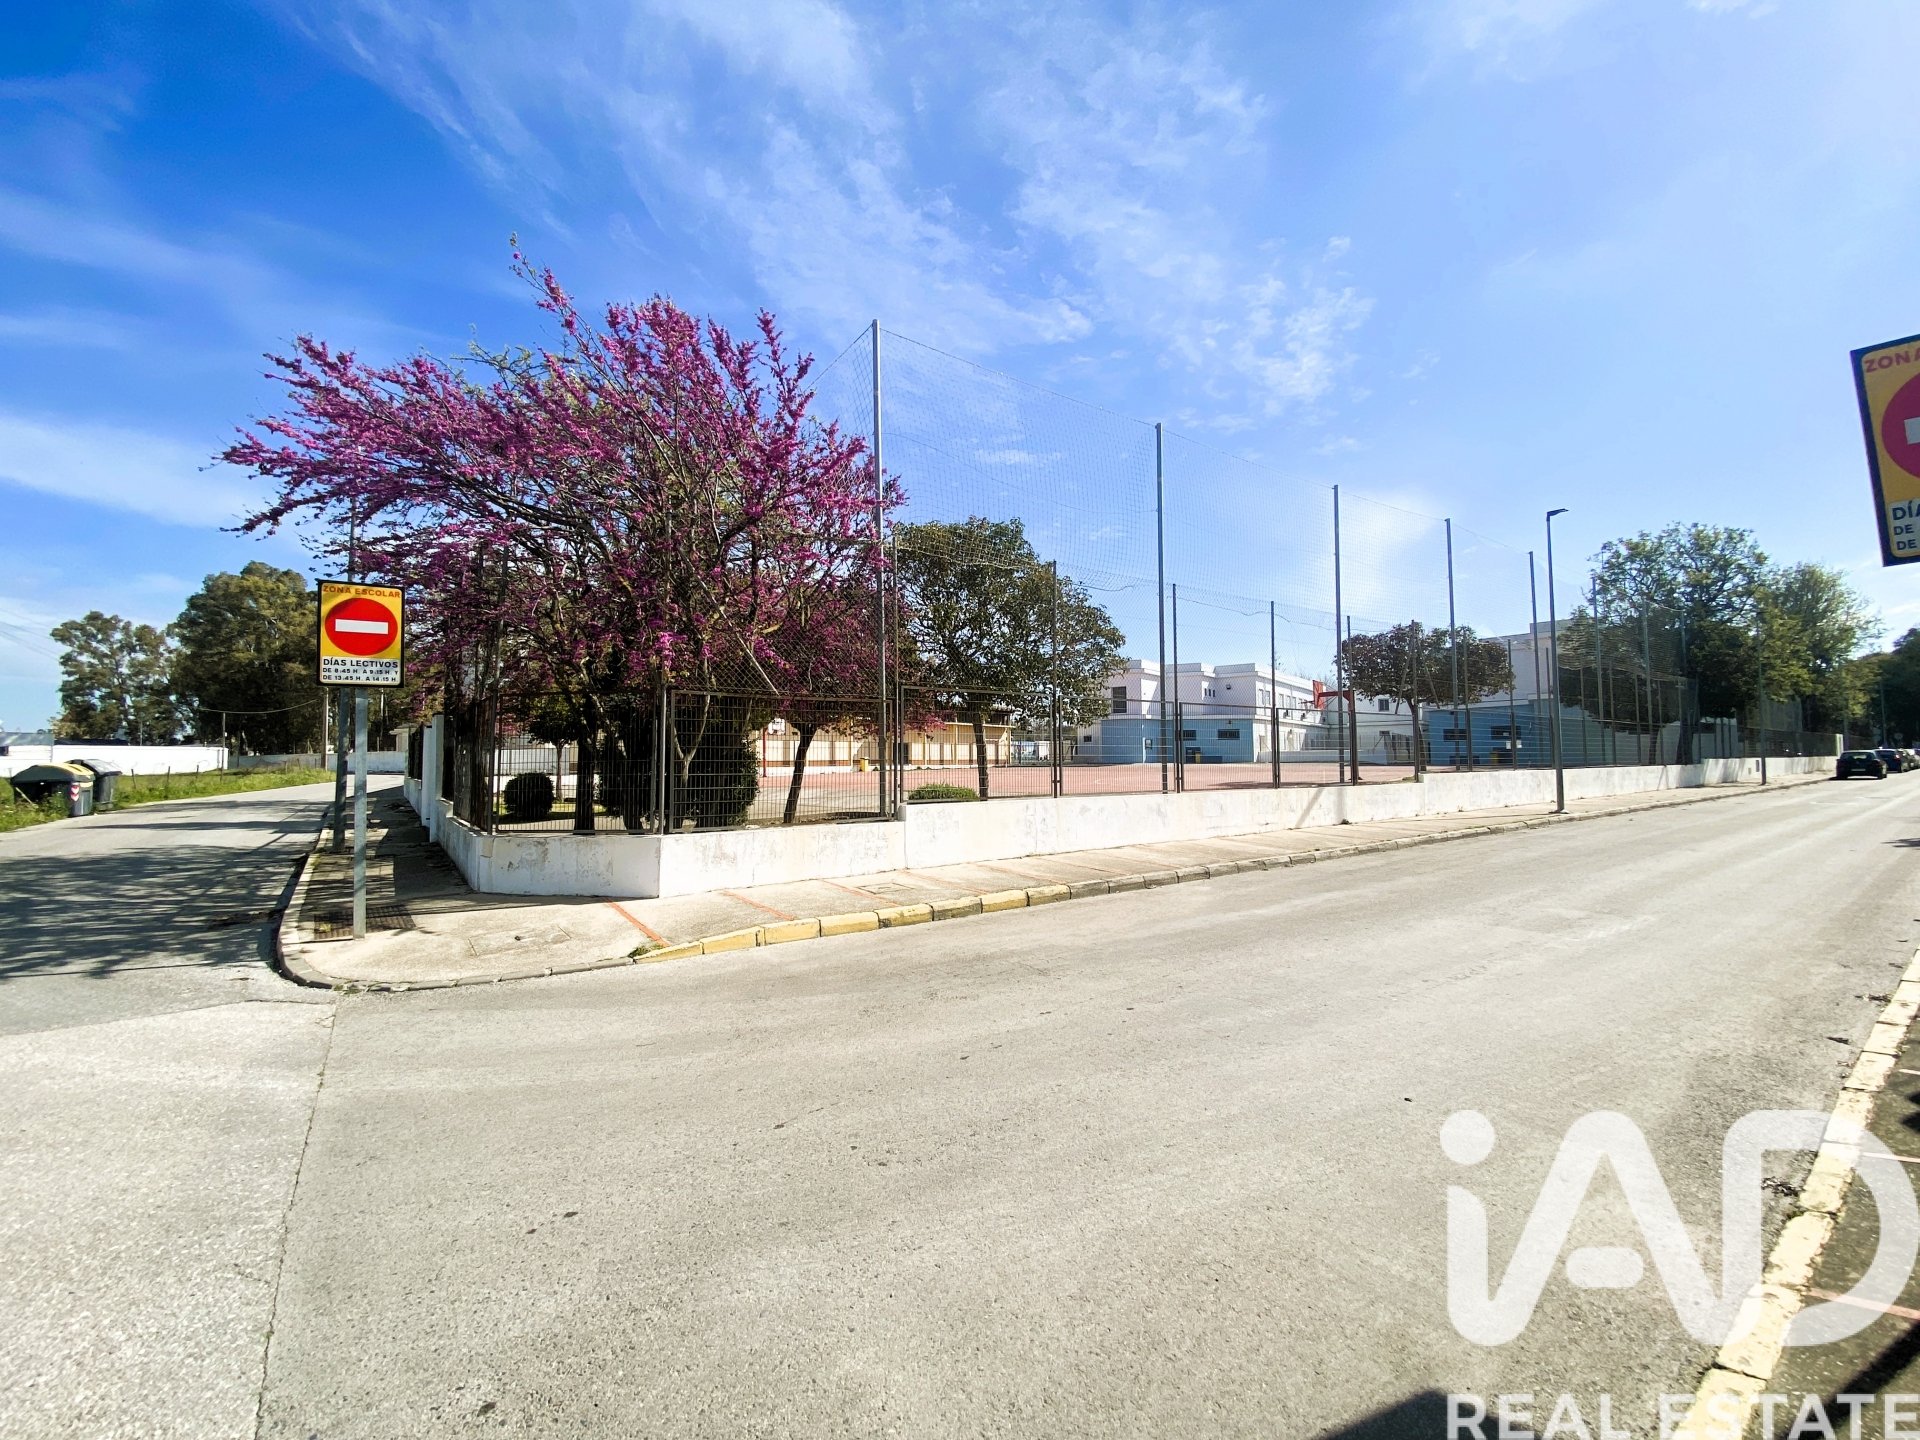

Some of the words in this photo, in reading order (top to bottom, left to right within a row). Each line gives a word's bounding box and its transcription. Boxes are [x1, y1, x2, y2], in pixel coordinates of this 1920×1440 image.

[1893, 524, 1914, 535] DE
[1896, 539, 1917, 550] DE
[323, 585, 351, 594] ZONA
[354, 588, 401, 598] ESCOLAR
[323, 657, 347, 666] DÍAS
[350, 659, 399, 668] LECTIVOS
